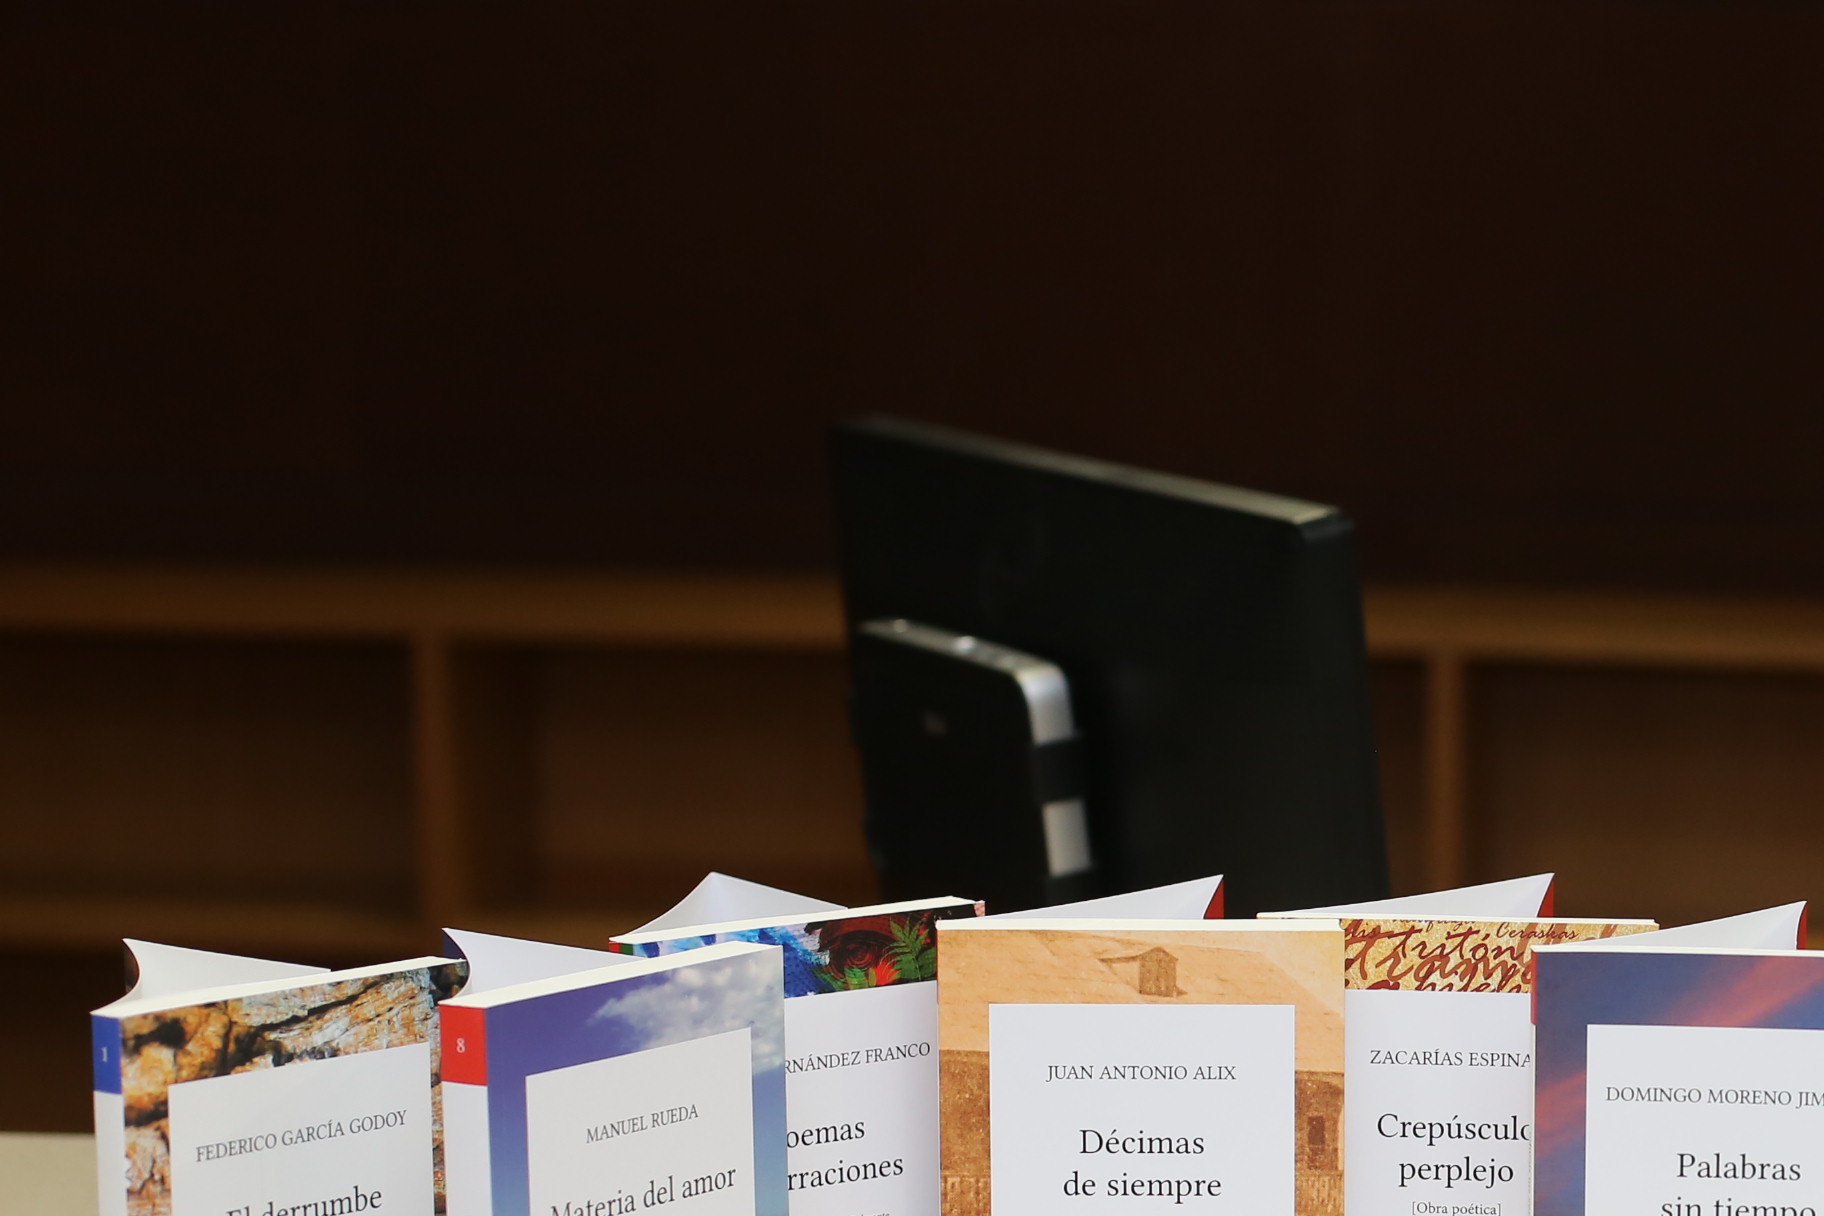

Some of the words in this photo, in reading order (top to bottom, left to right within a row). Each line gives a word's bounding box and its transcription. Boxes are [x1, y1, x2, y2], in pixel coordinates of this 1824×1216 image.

[456, 1038, 466, 1053] 8
[866, 1041, 930, 1063] FRANCO
[1370, 1048, 1463, 1065] ZACARÍAS
[1046, 1065, 1093, 1082] JUAN
[1100, 1066, 1187, 1079] ANTONIO
[1192, 1066, 1236, 1079] ALIX
[1606, 1086, 1701, 1103] DOMINGO
[1708, 1089, 1791, 1105] MORENO
[196, 1133, 277, 1162] FEDERICO
[282, 1119, 344, 1146] GARCÍA
[350, 1109, 406, 1134] GODOY
[586, 1116, 648, 1143] MANUEL
[650, 1104, 698, 1128] RUEDA
[1080, 1128, 1204, 1154] Décimas
[1398, 1156, 1513, 1189] perplejo
[1676, 1152, 1800, 1180] Palabras
[644, 1175, 674, 1208] del
[682, 1169, 736, 1198] amor
[1064, 1171, 1095, 1196] de
[1108, 1172, 1221, 1204] siempre
[1412, 1202, 1448, 1215] [Obra
[1452, 1202, 1501, 1216] poética]
